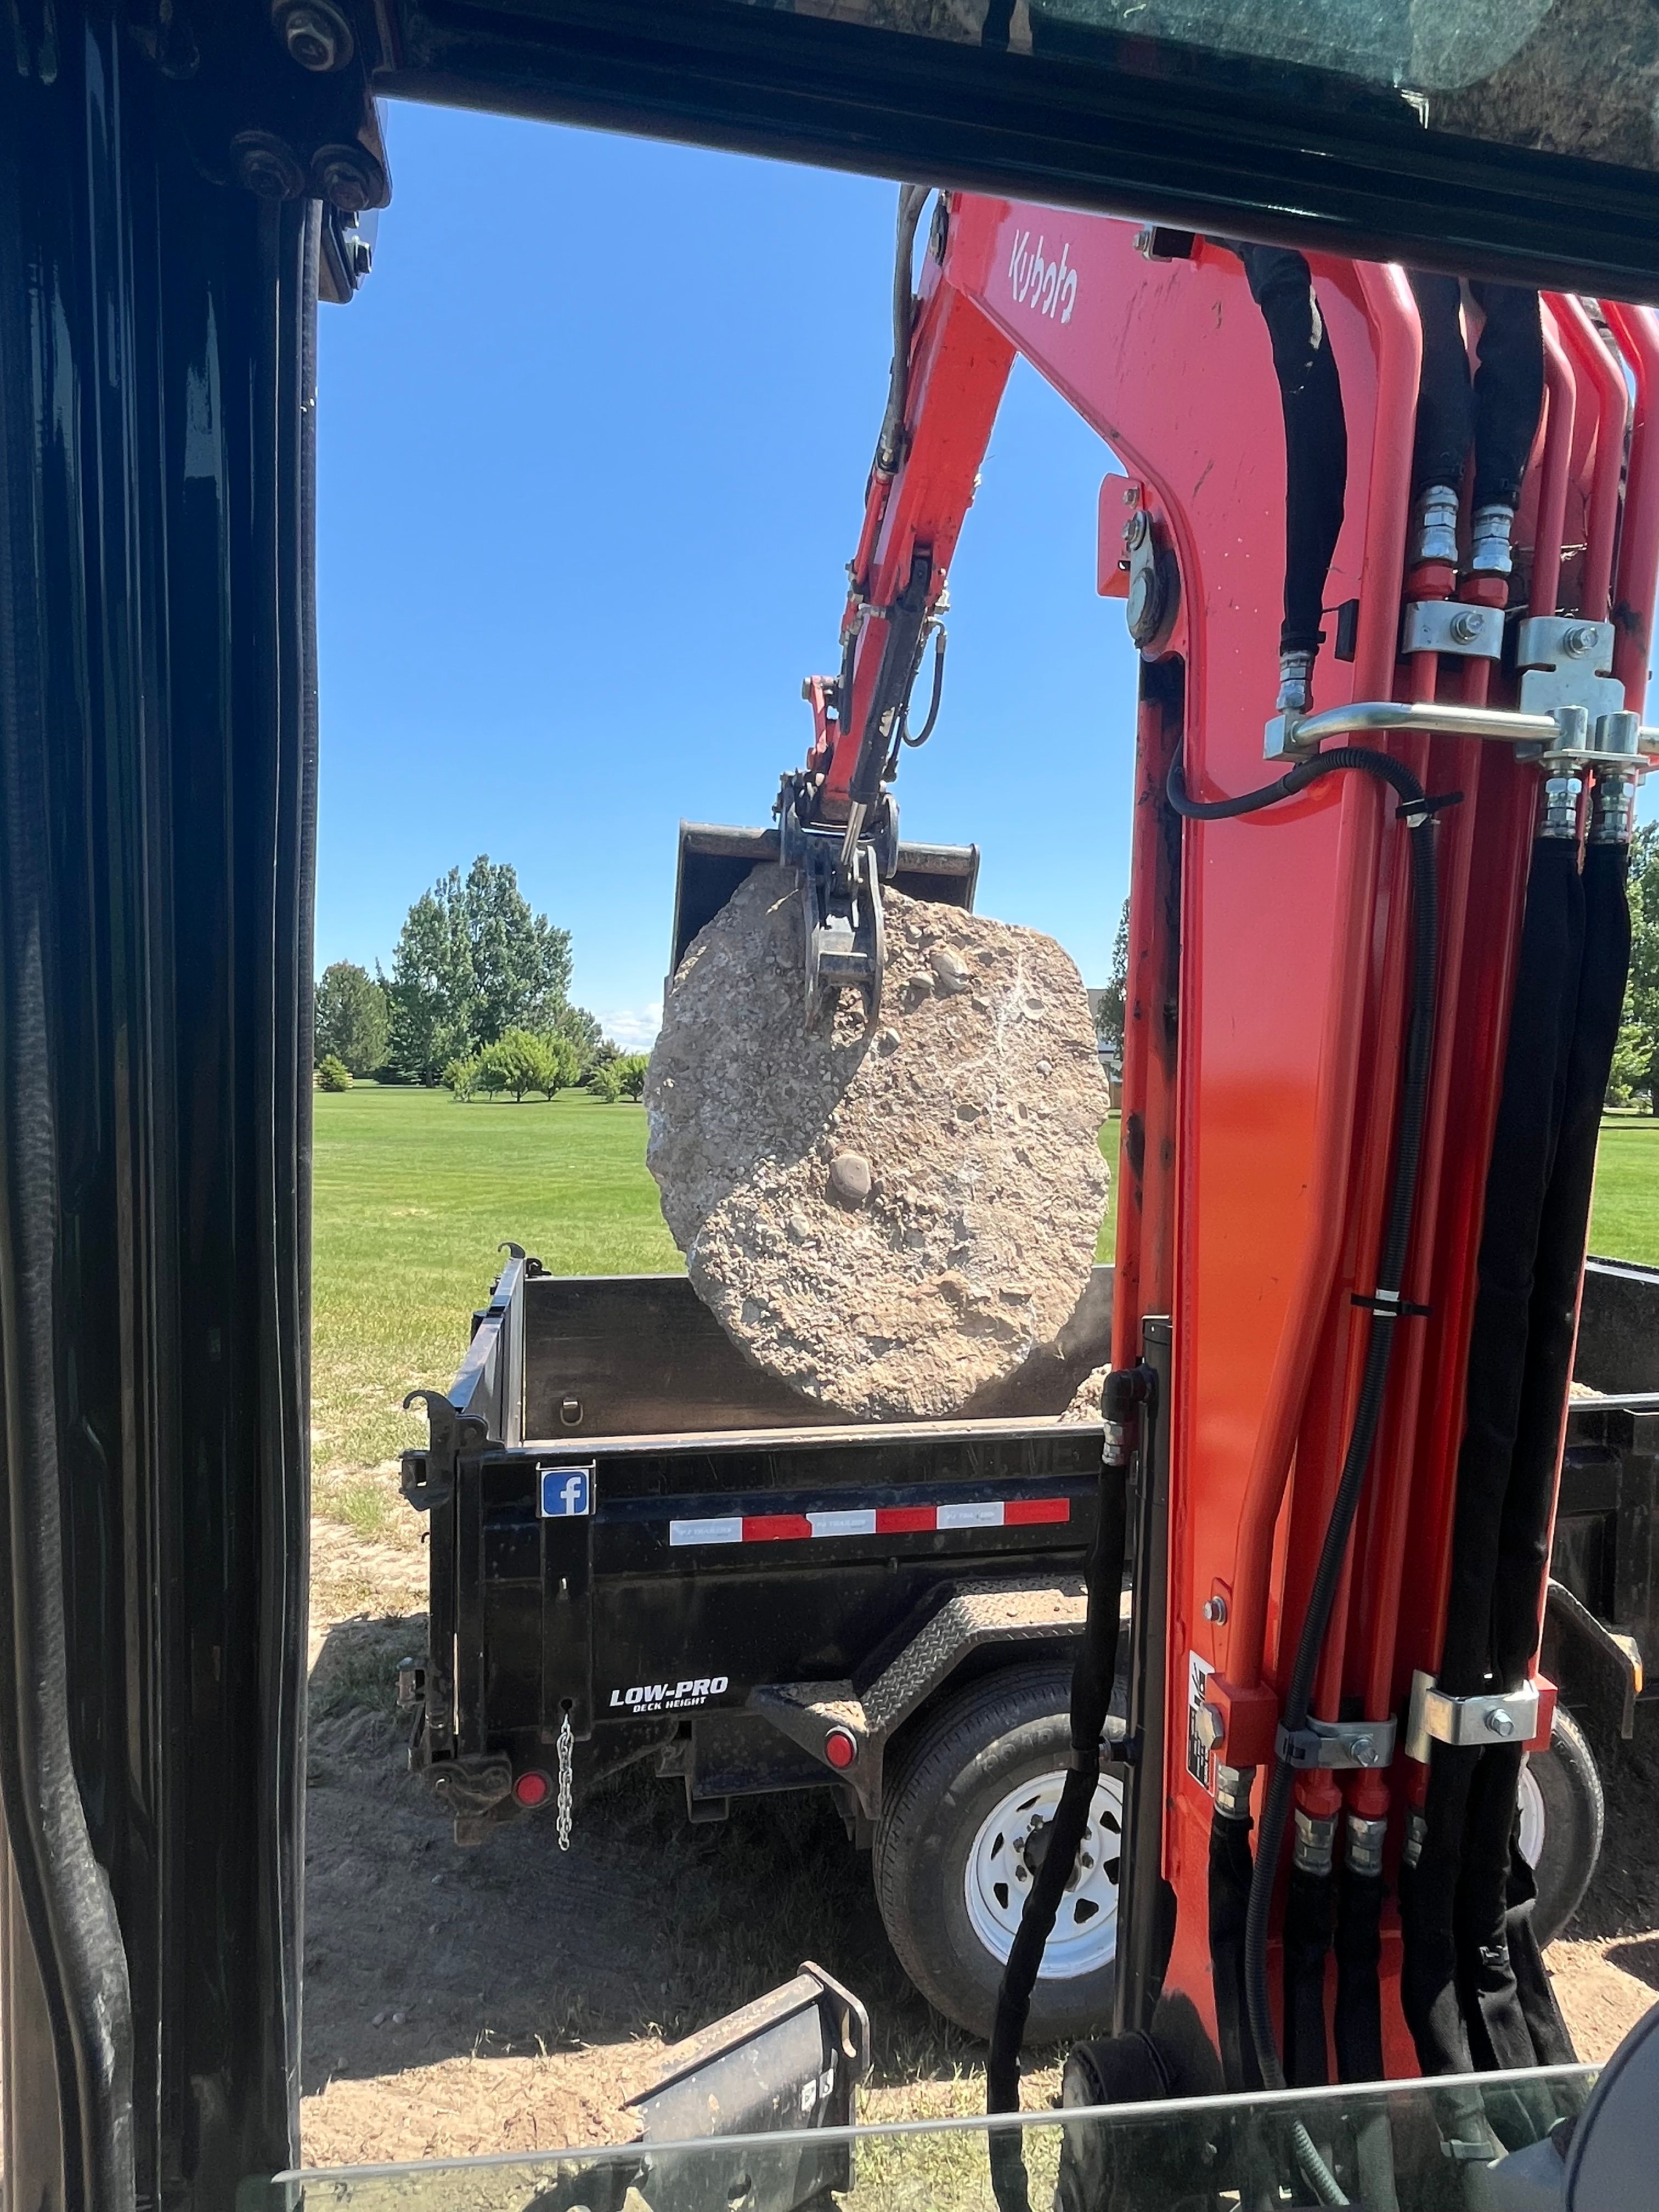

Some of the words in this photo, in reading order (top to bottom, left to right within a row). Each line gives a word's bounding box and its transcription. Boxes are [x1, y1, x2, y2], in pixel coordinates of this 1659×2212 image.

[1008, 229, 1077, 324] Kubota
[610, 1677, 729, 1707] LOW-PRO
[633, 1702, 662, 1713] DECK
[665, 1696, 707, 1708] HEIGHT
